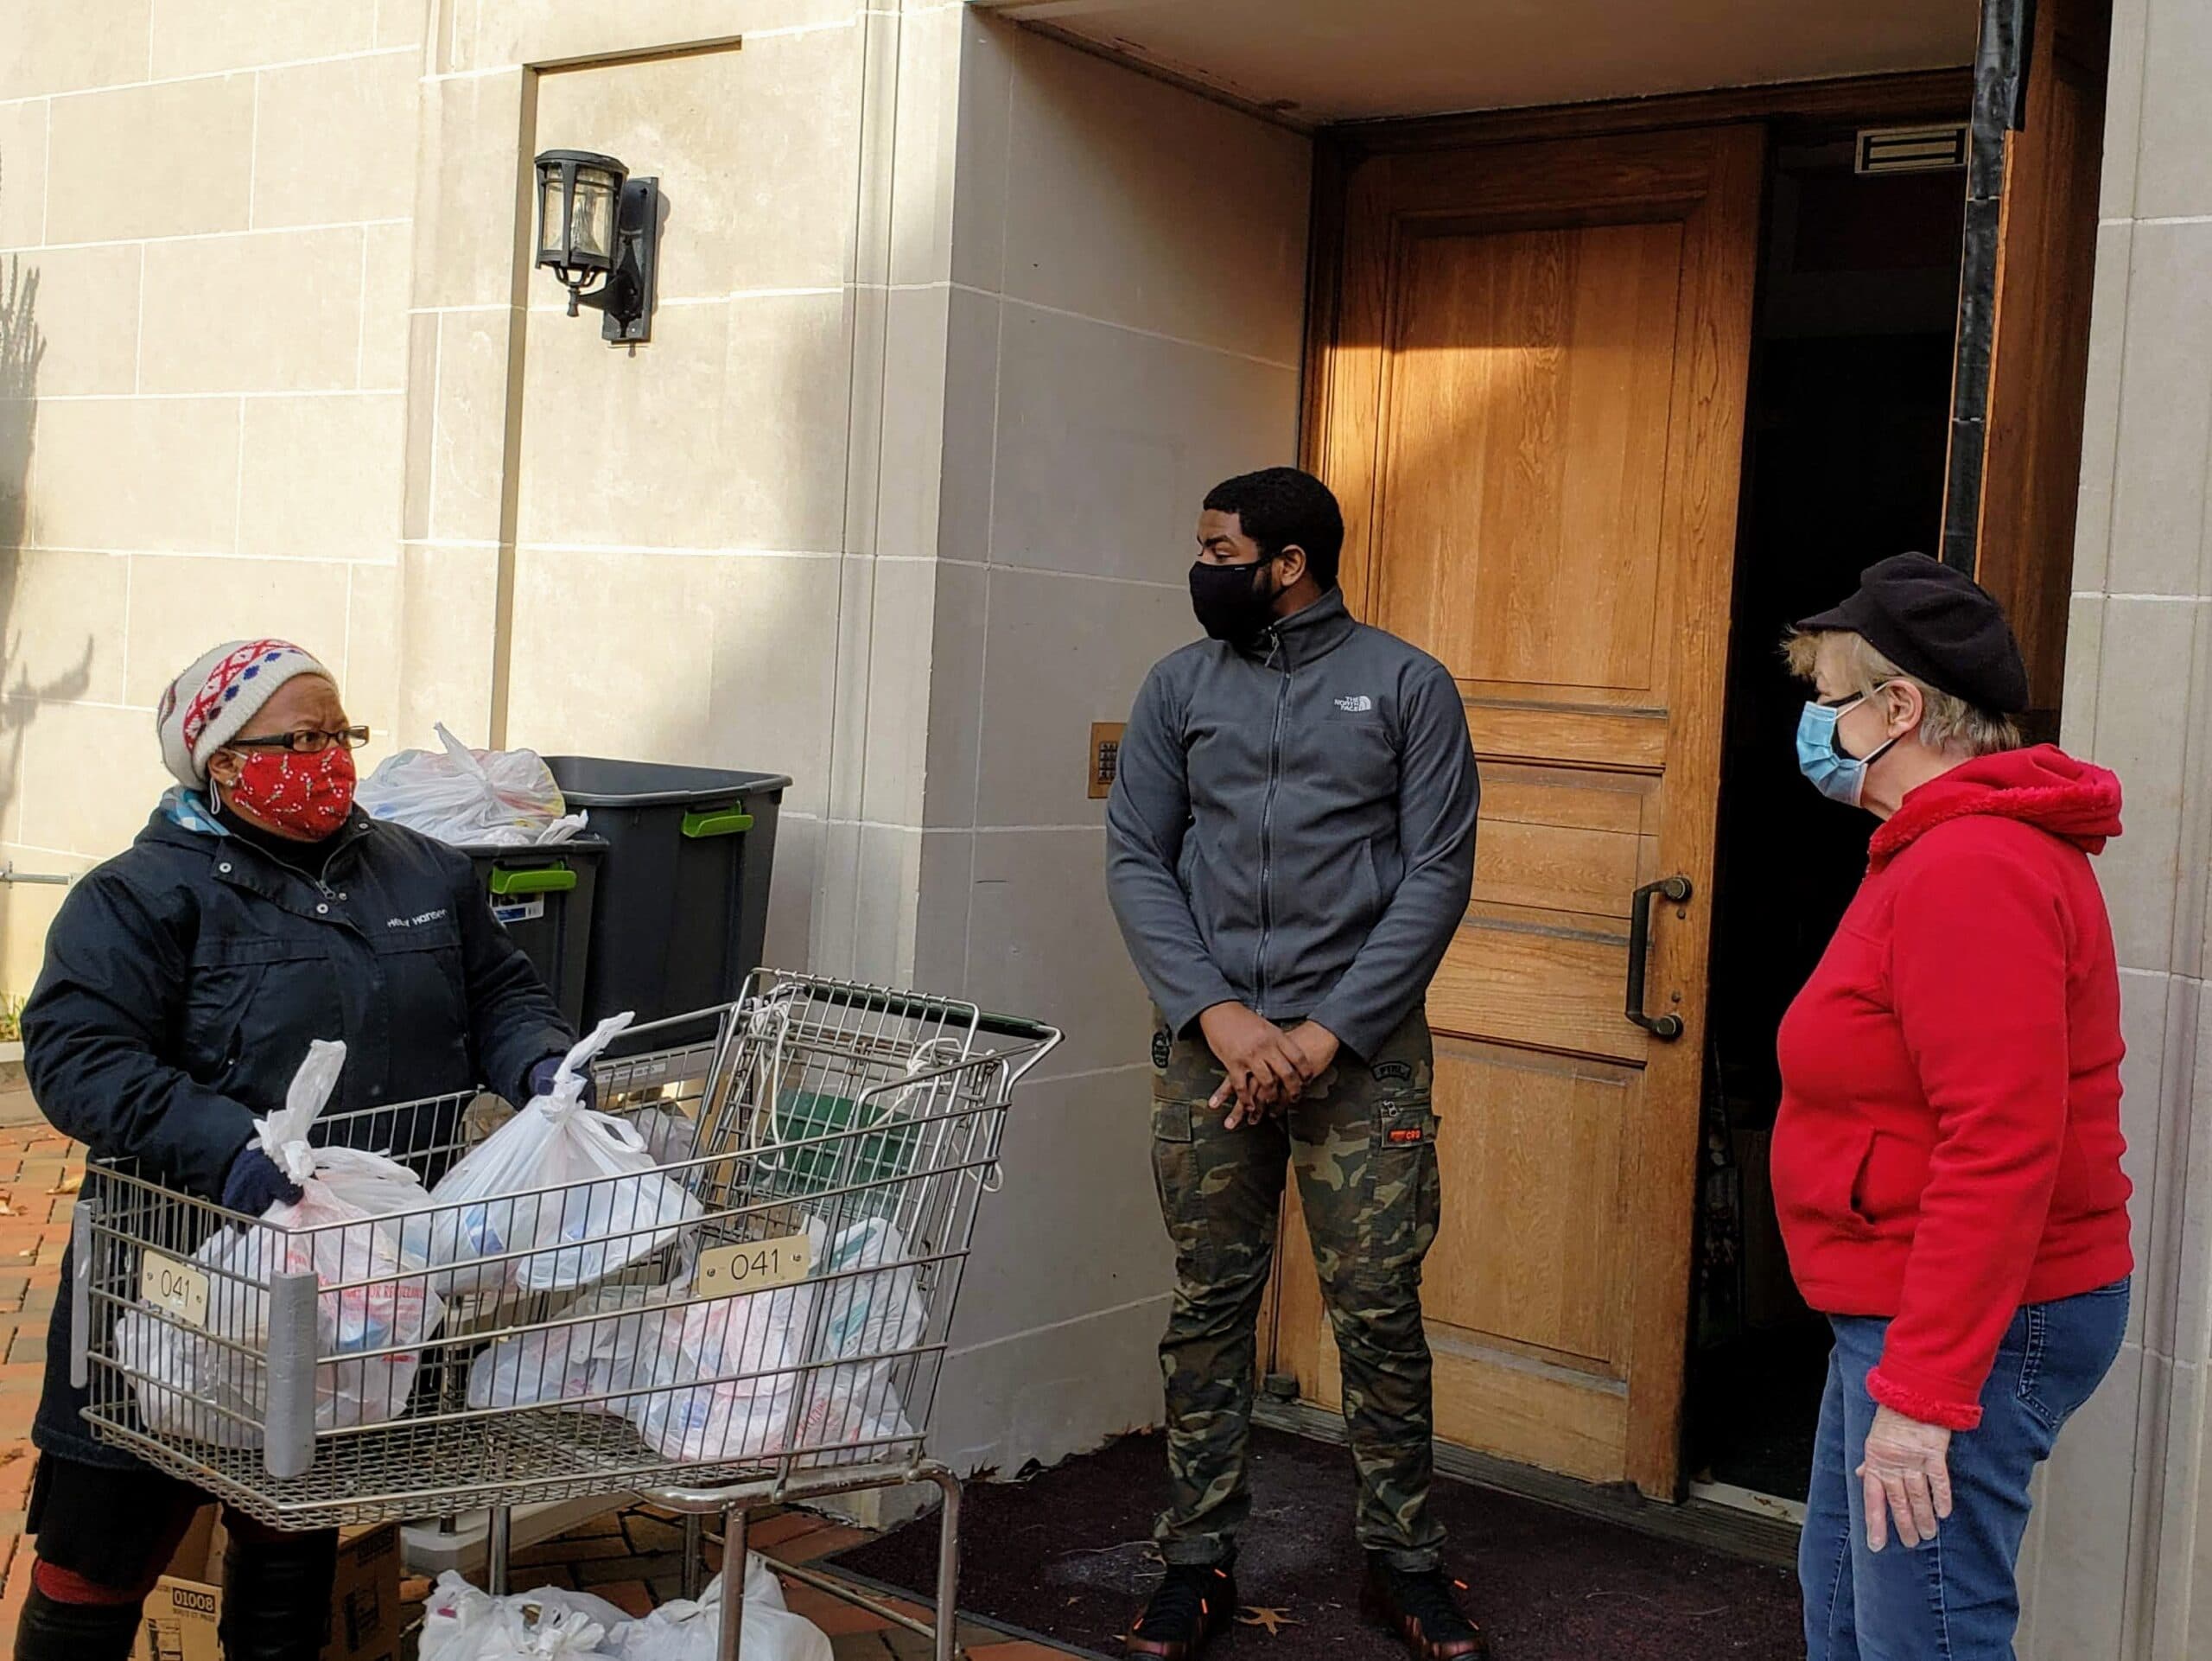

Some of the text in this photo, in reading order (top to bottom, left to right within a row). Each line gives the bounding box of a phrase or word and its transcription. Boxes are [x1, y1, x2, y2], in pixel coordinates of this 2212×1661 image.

[731, 1248, 779, 1280] 041
[161, 1269, 190, 1308] 041
[174, 1589, 214, 1612] 01008
